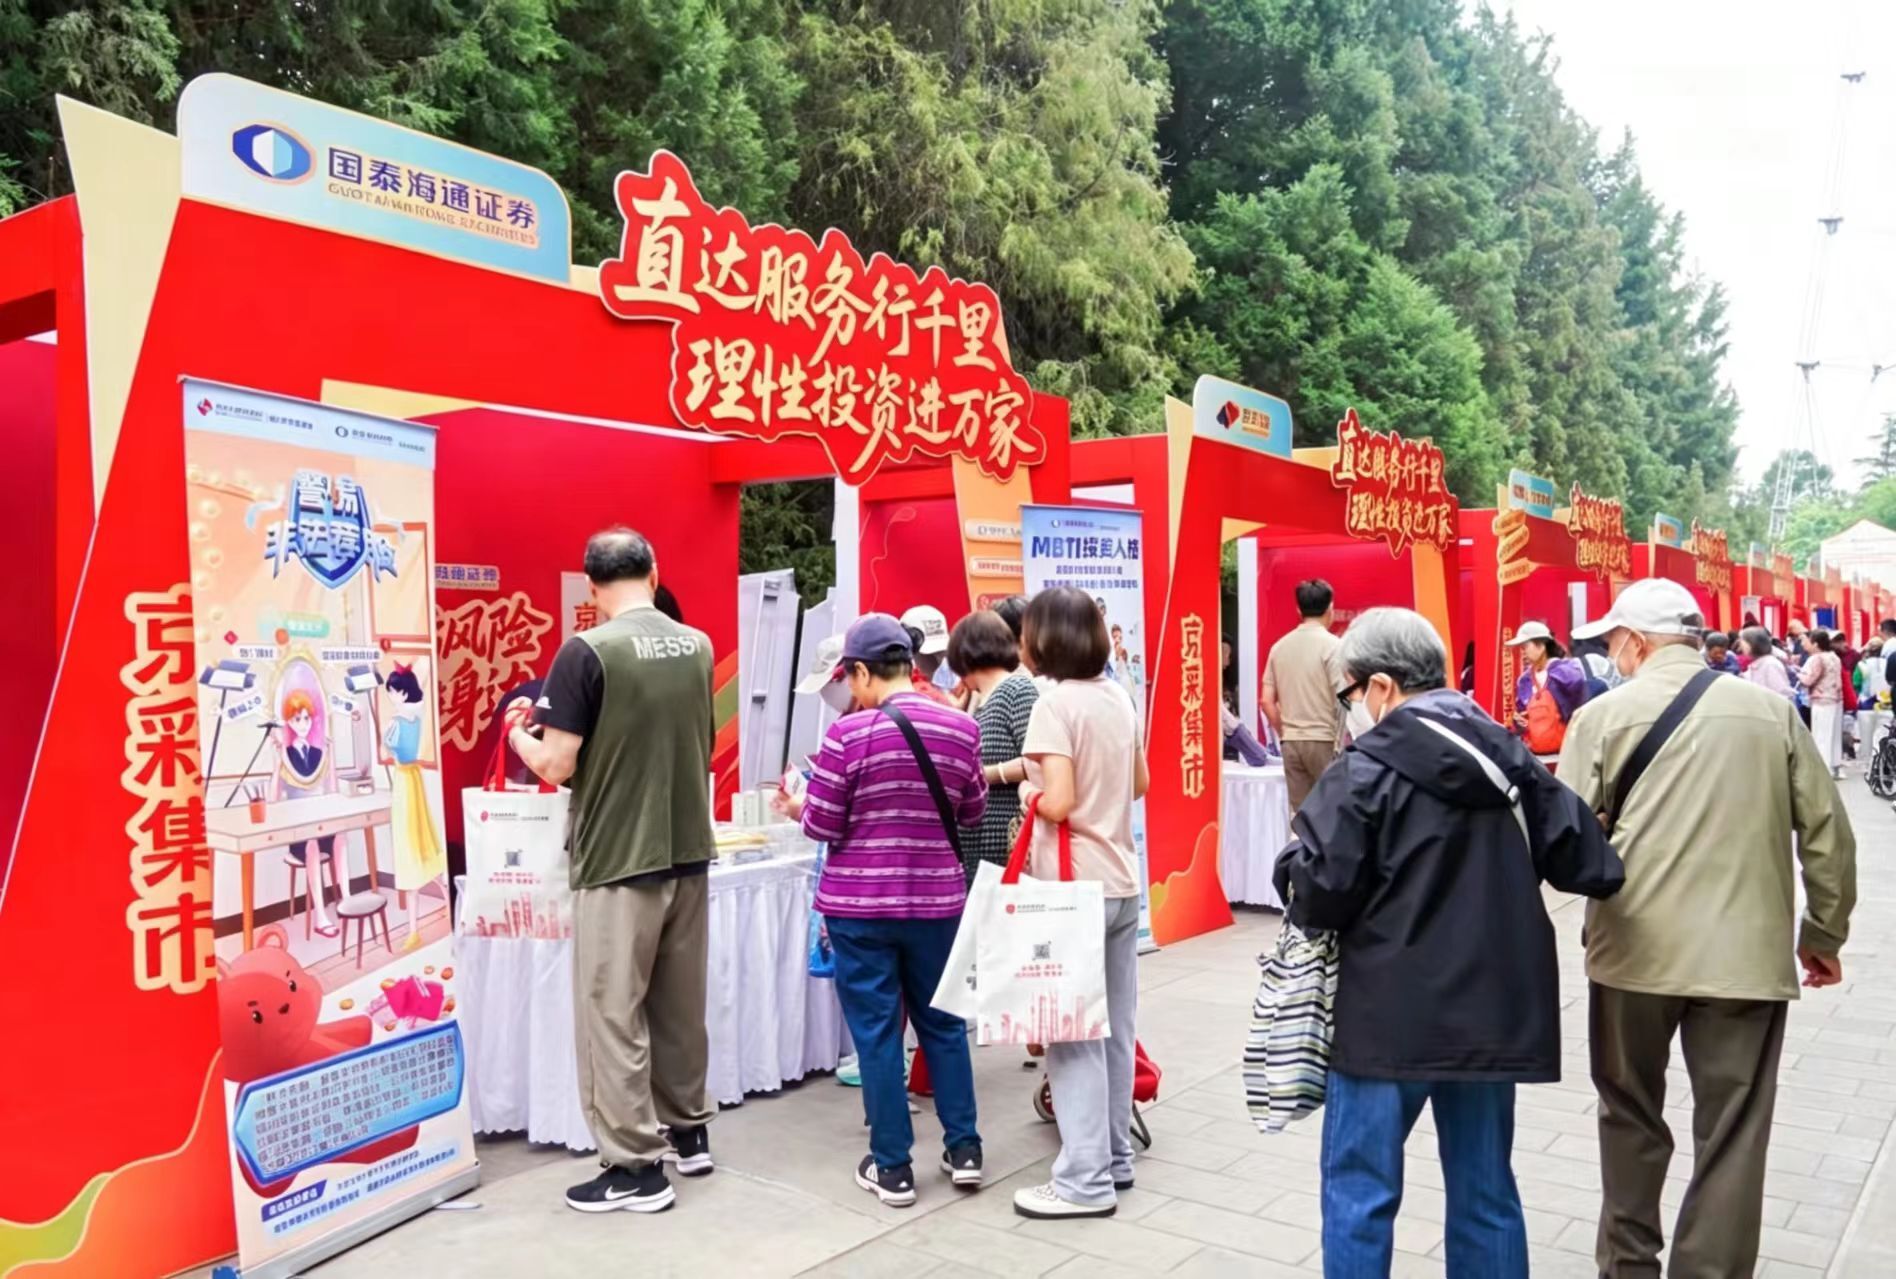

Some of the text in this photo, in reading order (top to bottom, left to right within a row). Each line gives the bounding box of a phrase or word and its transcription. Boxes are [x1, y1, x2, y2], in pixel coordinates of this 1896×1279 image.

[328, 147, 536, 229] 国泰海通证券
[613, 176, 997, 371] 直达服务行千里
[684, 337, 1037, 473] 理性投资进万家
[437, 597, 549, 662] 风险
